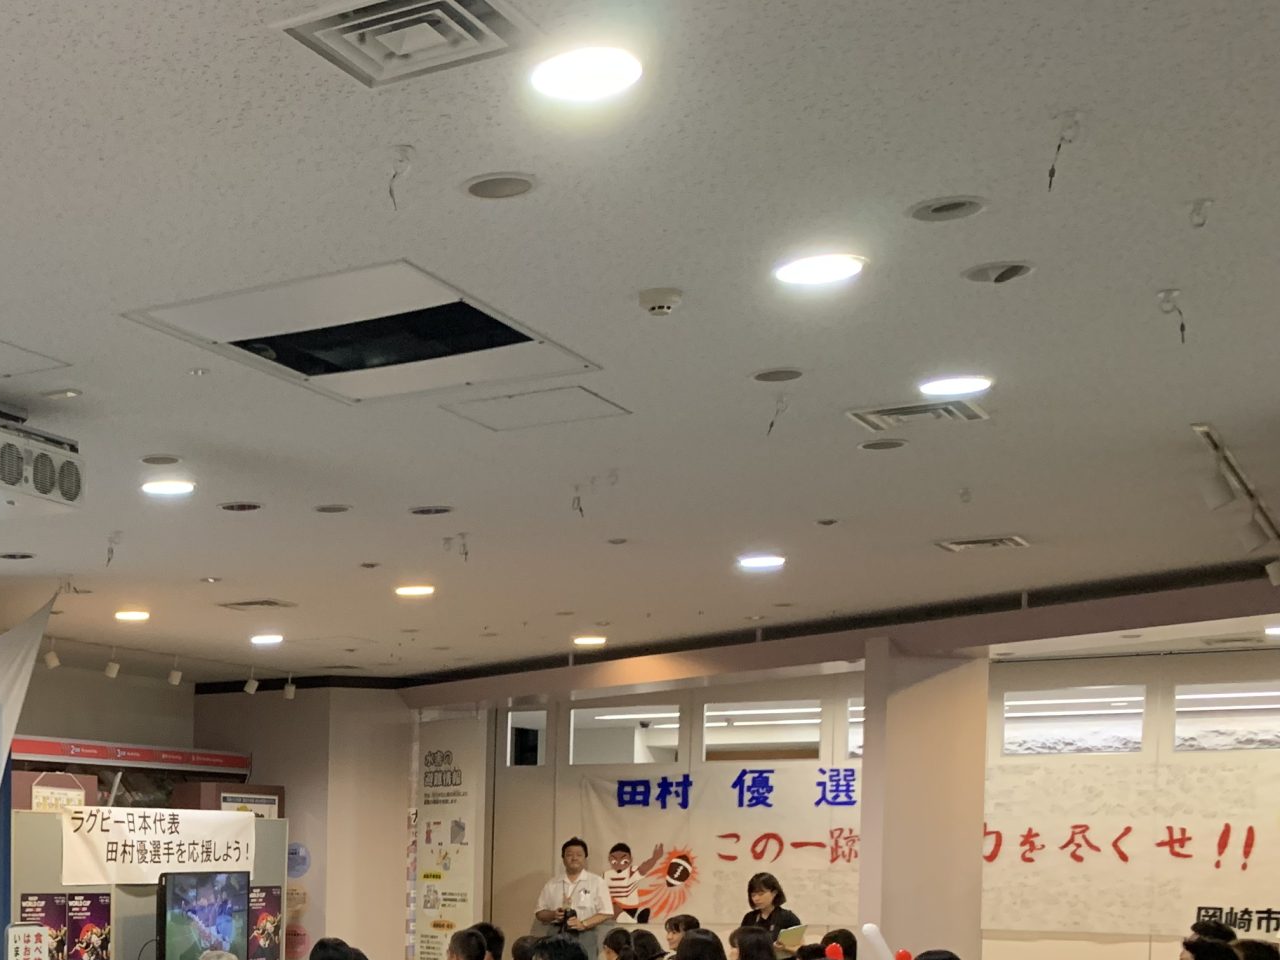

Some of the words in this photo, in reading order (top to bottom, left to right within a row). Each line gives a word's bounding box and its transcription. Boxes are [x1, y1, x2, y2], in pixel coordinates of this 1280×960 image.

[617, 774, 693, 809] 田村
[731, 768, 775, 808] 優
[71, 809, 180, 835] ラグビー日本代表
